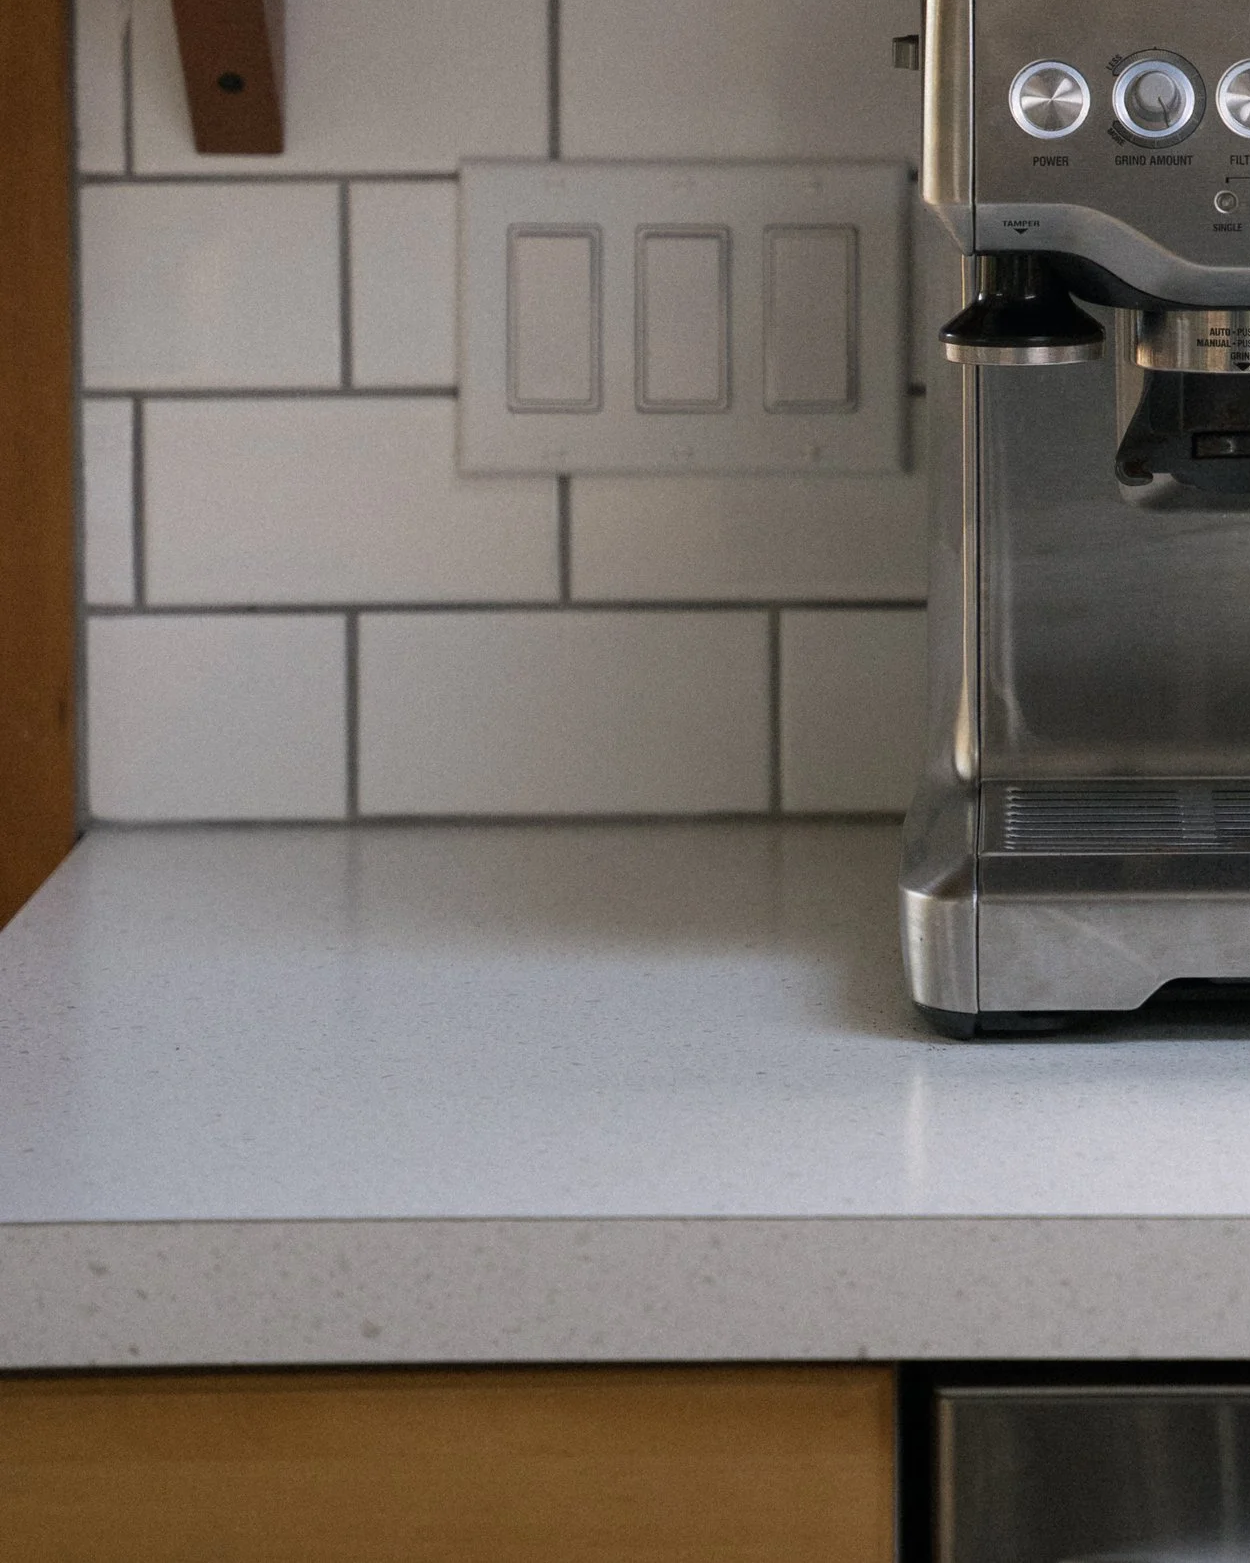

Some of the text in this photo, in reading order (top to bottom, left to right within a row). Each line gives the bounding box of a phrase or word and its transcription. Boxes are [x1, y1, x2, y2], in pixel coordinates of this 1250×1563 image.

[1105, 54, 1123, 72] LESS
[1032, 155, 1069, 167] POWER
[1114, 155, 1194, 166] GRIND AMOUNT
[1213, 223, 1242, 232] SINGLE
[1209, 327, 1231, 337] AUTO
[1196, 339, 1231, 348] MANUAL
